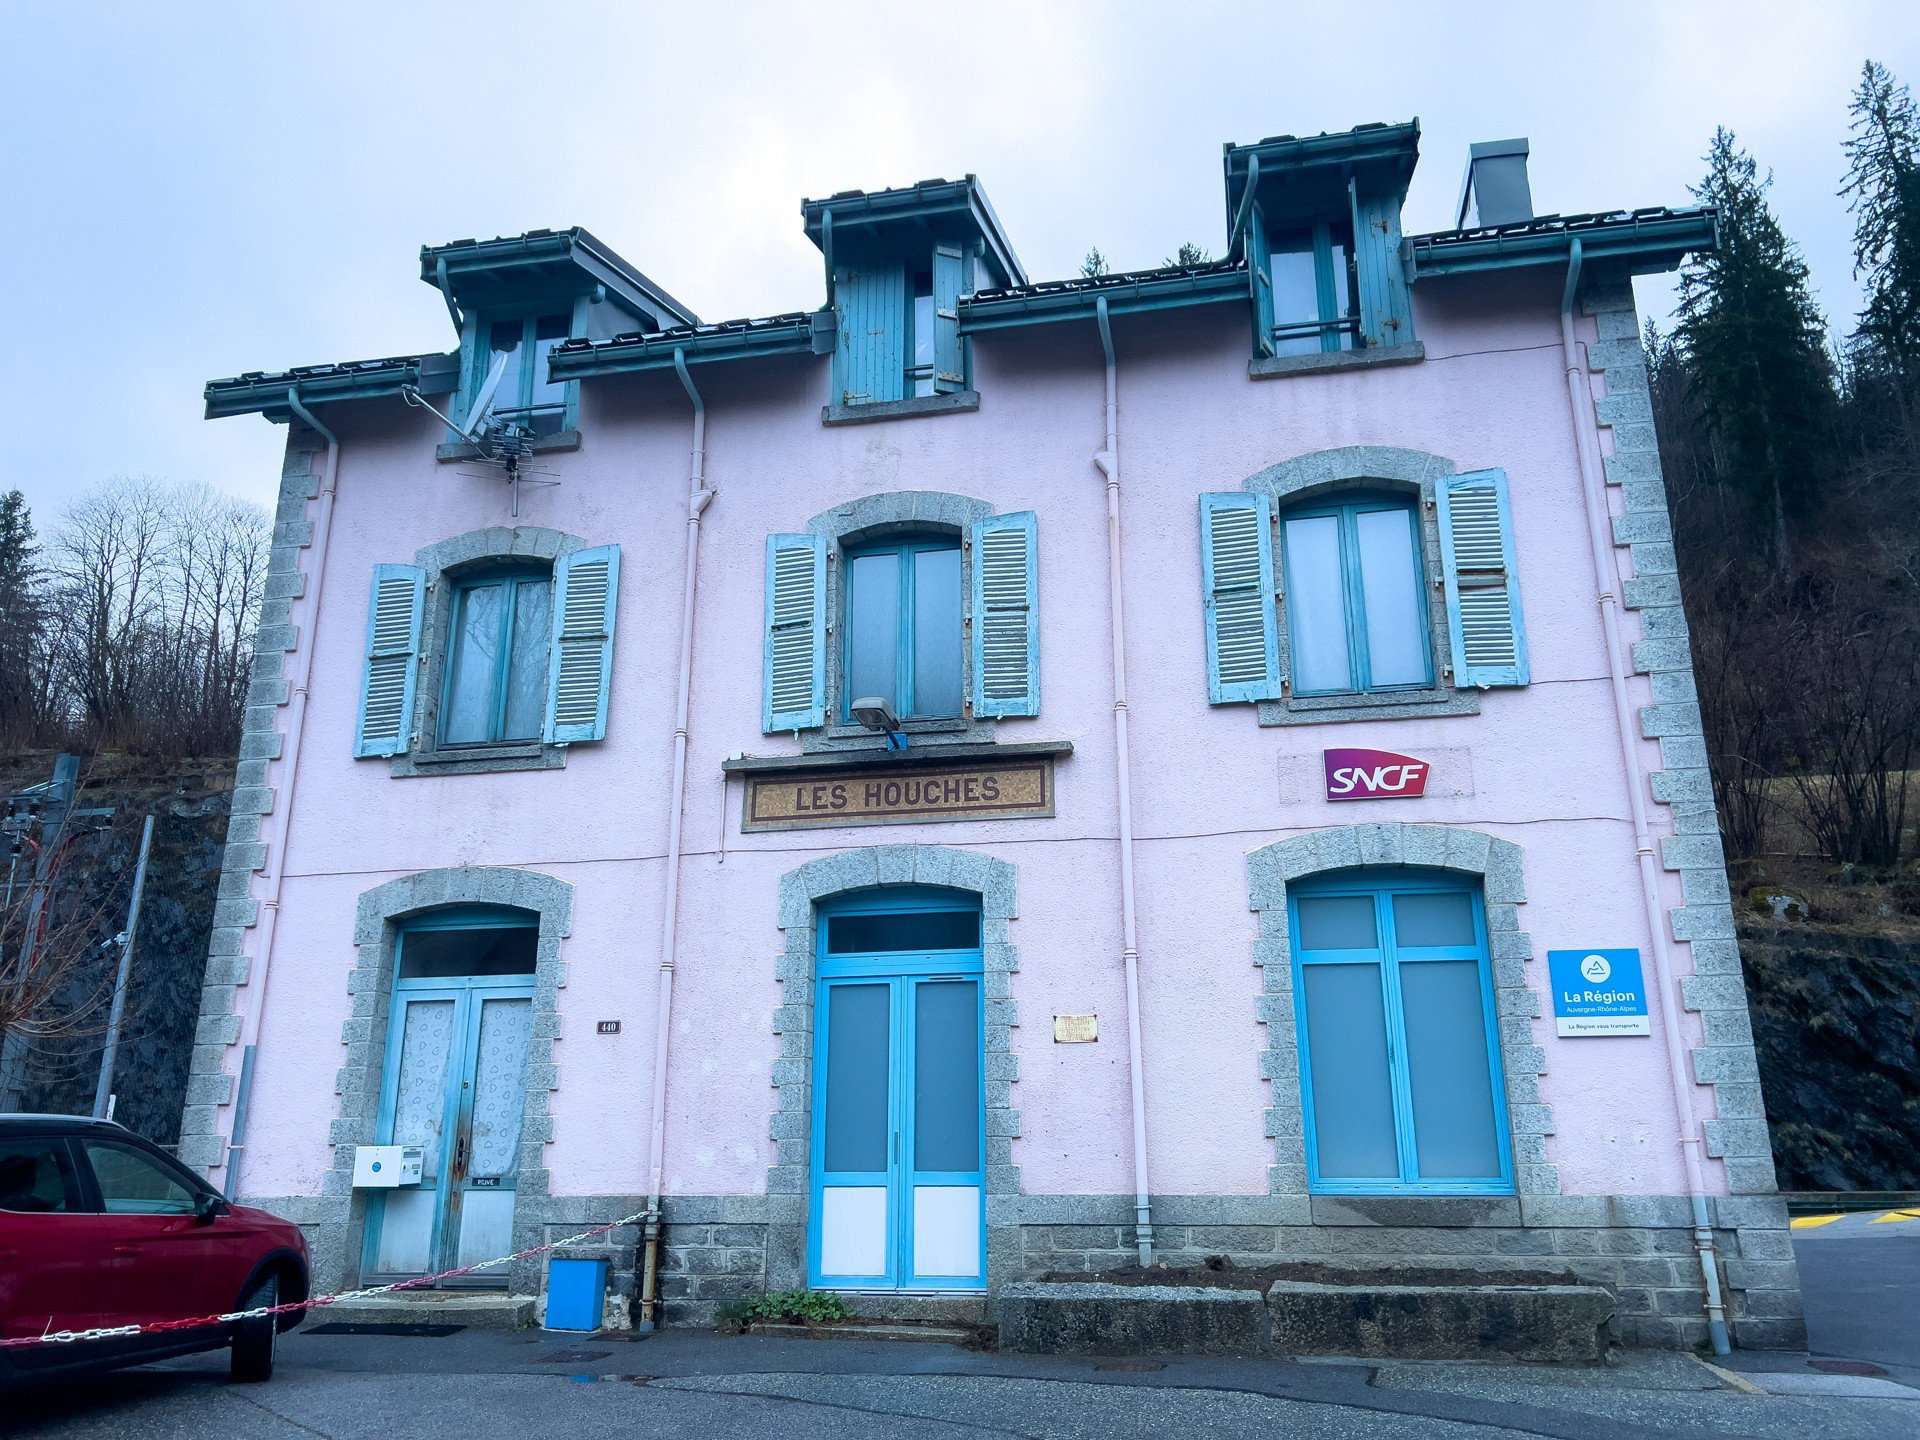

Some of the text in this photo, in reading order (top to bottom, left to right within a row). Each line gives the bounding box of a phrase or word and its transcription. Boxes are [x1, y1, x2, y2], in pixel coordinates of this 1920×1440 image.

[1329, 764, 1424, 793] SNCF
[796, 776, 1001, 811] LES HOUCHES
[1564, 990, 1635, 1004] La Région
[1566, 1005, 1637, 1013] Auvergne-Rhône-Alpes
[601, 1022, 616, 1031] 440
